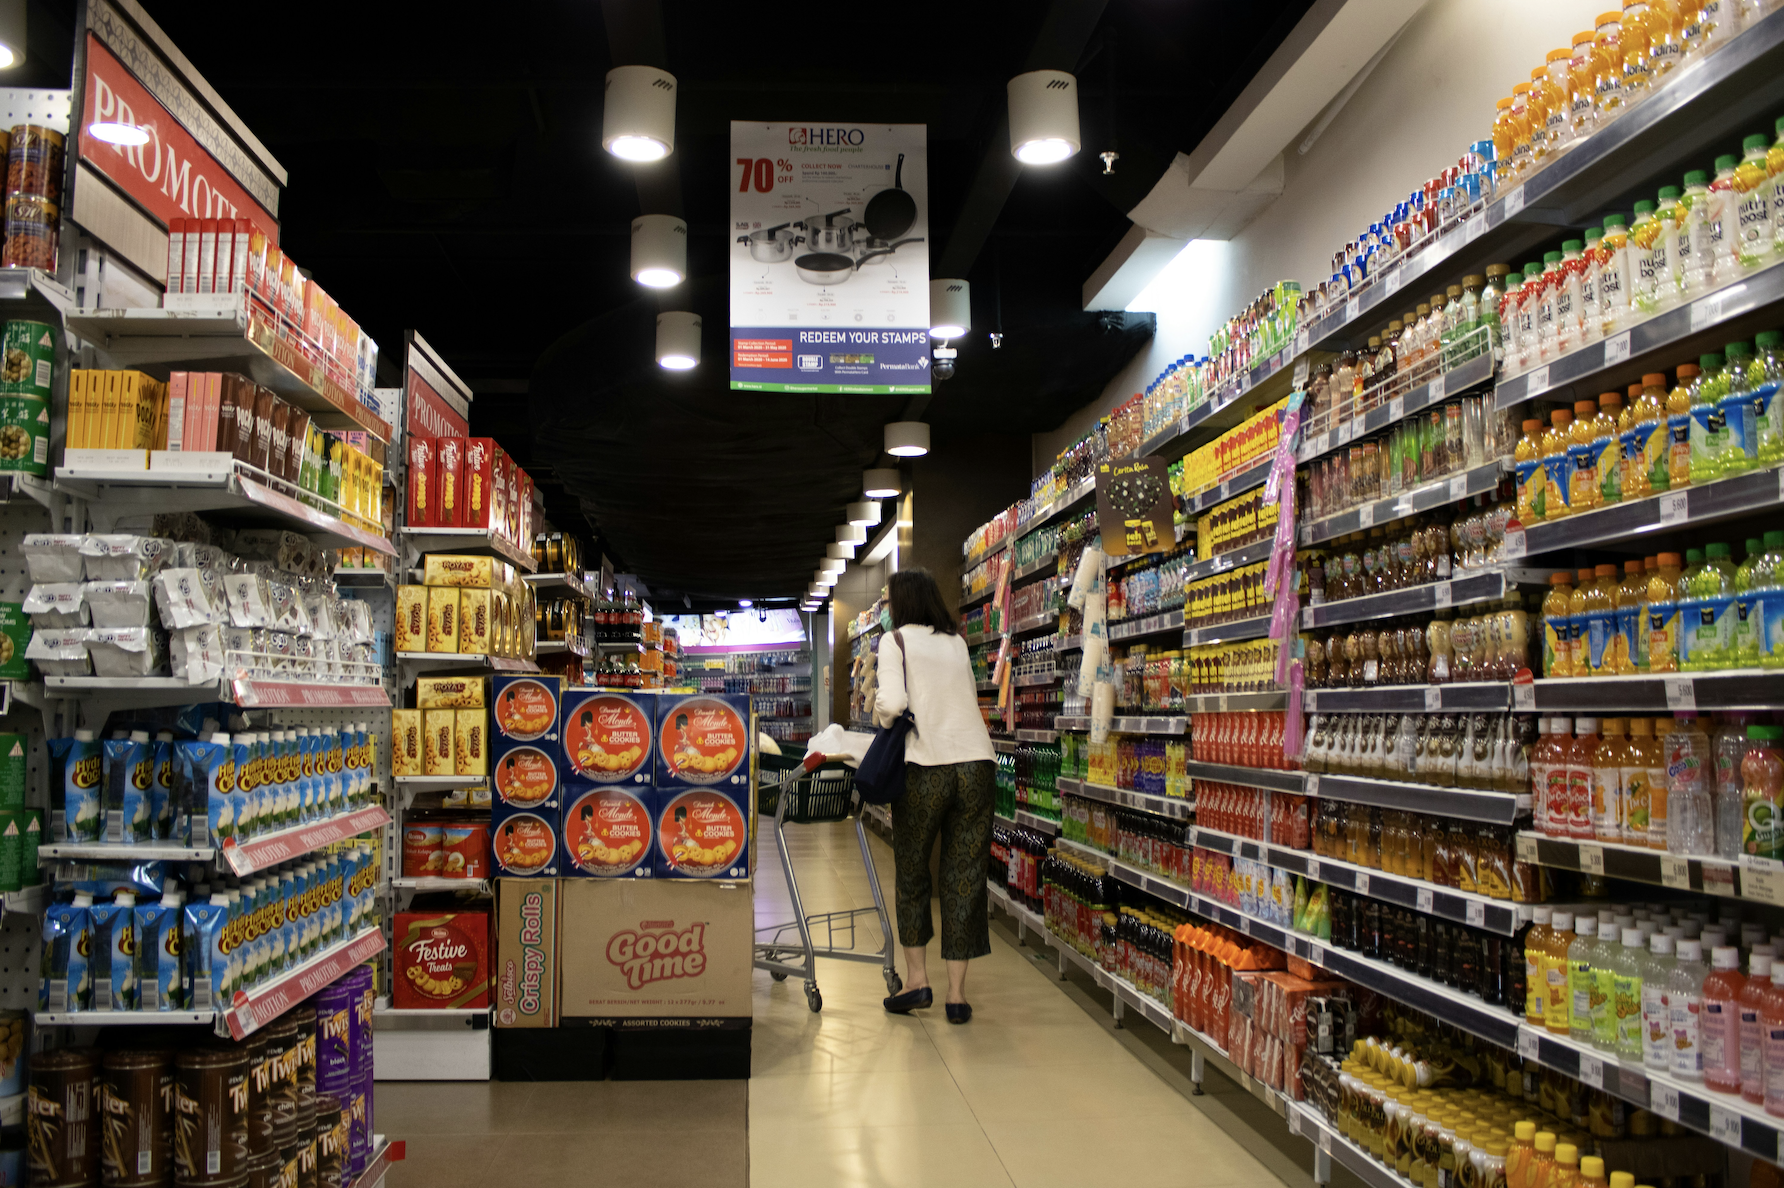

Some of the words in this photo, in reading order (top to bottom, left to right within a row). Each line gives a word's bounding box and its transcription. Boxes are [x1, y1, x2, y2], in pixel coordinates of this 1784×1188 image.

[810, 128, 865, 146] HERO
[803, 145, 822, 153] fresh
[823, 145, 839, 153] food
[839, 146, 864, 154] people
[777, 175, 794, 184] OFF
[1738, 198, 1767, 215] nutri
[1739, 210, 1768, 226] boost
[799, 331, 846, 344] REDEEM
[849, 331, 879, 344] YOUR
[881, 332, 927, 345] STAMPS
[880, 362, 921, 370] PermataBank
[354, 404, 386, 437] PROMOTION
[1113, 465, 1134, 476] Cerita
[1133, 462, 1149, 472] Rasa
[301, 689, 342, 704] PROMOTION
[599, 705, 621, 714] Danish
[694, 708, 716, 716] Danish
[599, 800, 621, 808] Danish
[692, 800, 715, 808] Danish
[349, 811, 385, 831] PROMOTION
[299, 825, 343, 848] PROMOTION
[521, 893, 542, 945] Rolls
[347, 934, 382, 963] PROMOTION
[408, 938, 468, 964] Festive
[607, 923, 704, 965] Good
[426, 961, 453, 974] Treats
[621, 952, 706, 989] Time
[299, 959, 341, 994] PROMOTION
[519, 945, 544, 1015] Crispy
[318, 1011, 349, 1041] Twis
[622, 1019, 658, 1027] ASSORTED
[660, 1019, 691, 1027] COOKIES
[268, 1051, 297, 1083] Twis
[27, 1095, 61, 1117] ster
